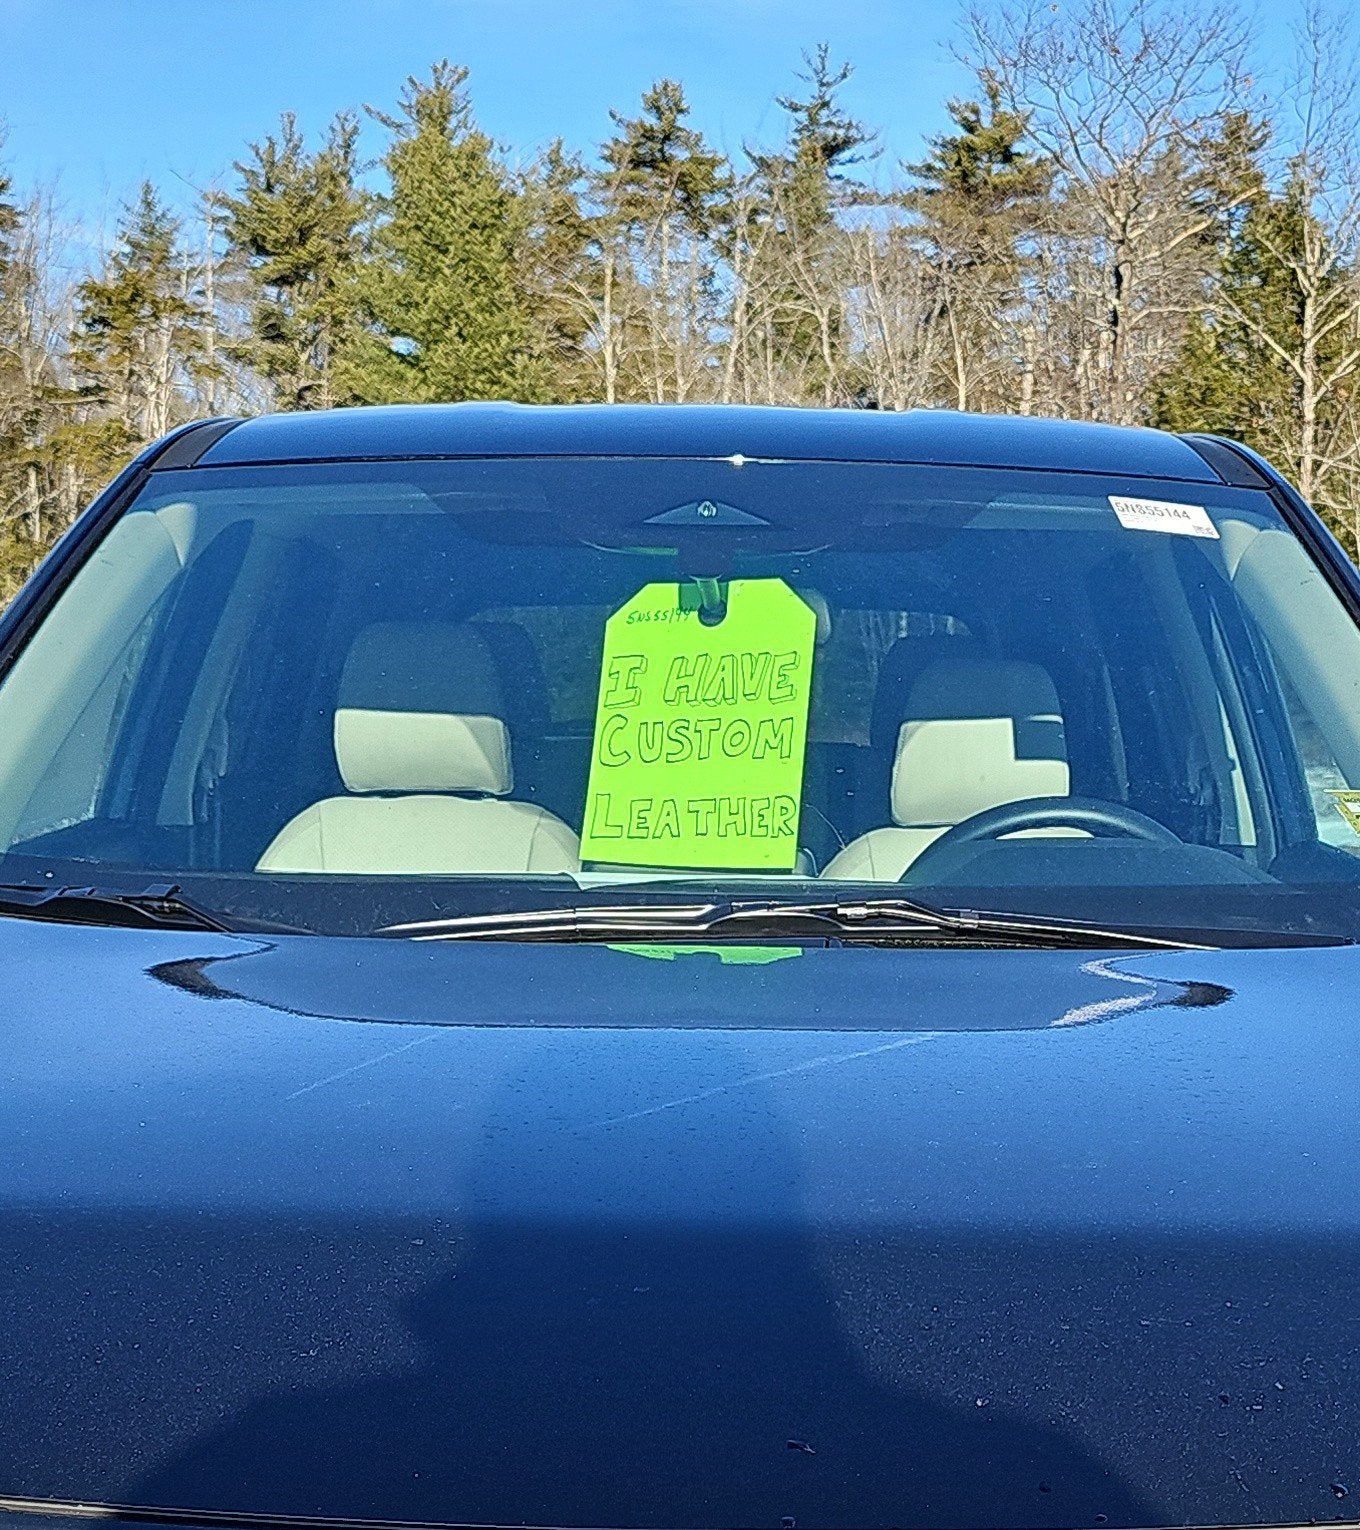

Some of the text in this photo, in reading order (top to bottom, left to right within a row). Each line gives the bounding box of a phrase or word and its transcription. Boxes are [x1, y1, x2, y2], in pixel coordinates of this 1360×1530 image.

[604, 651, 800, 709] I HAVE
[598, 714, 795, 767] CUSTOM
[590, 793, 797, 839] LEATHER
